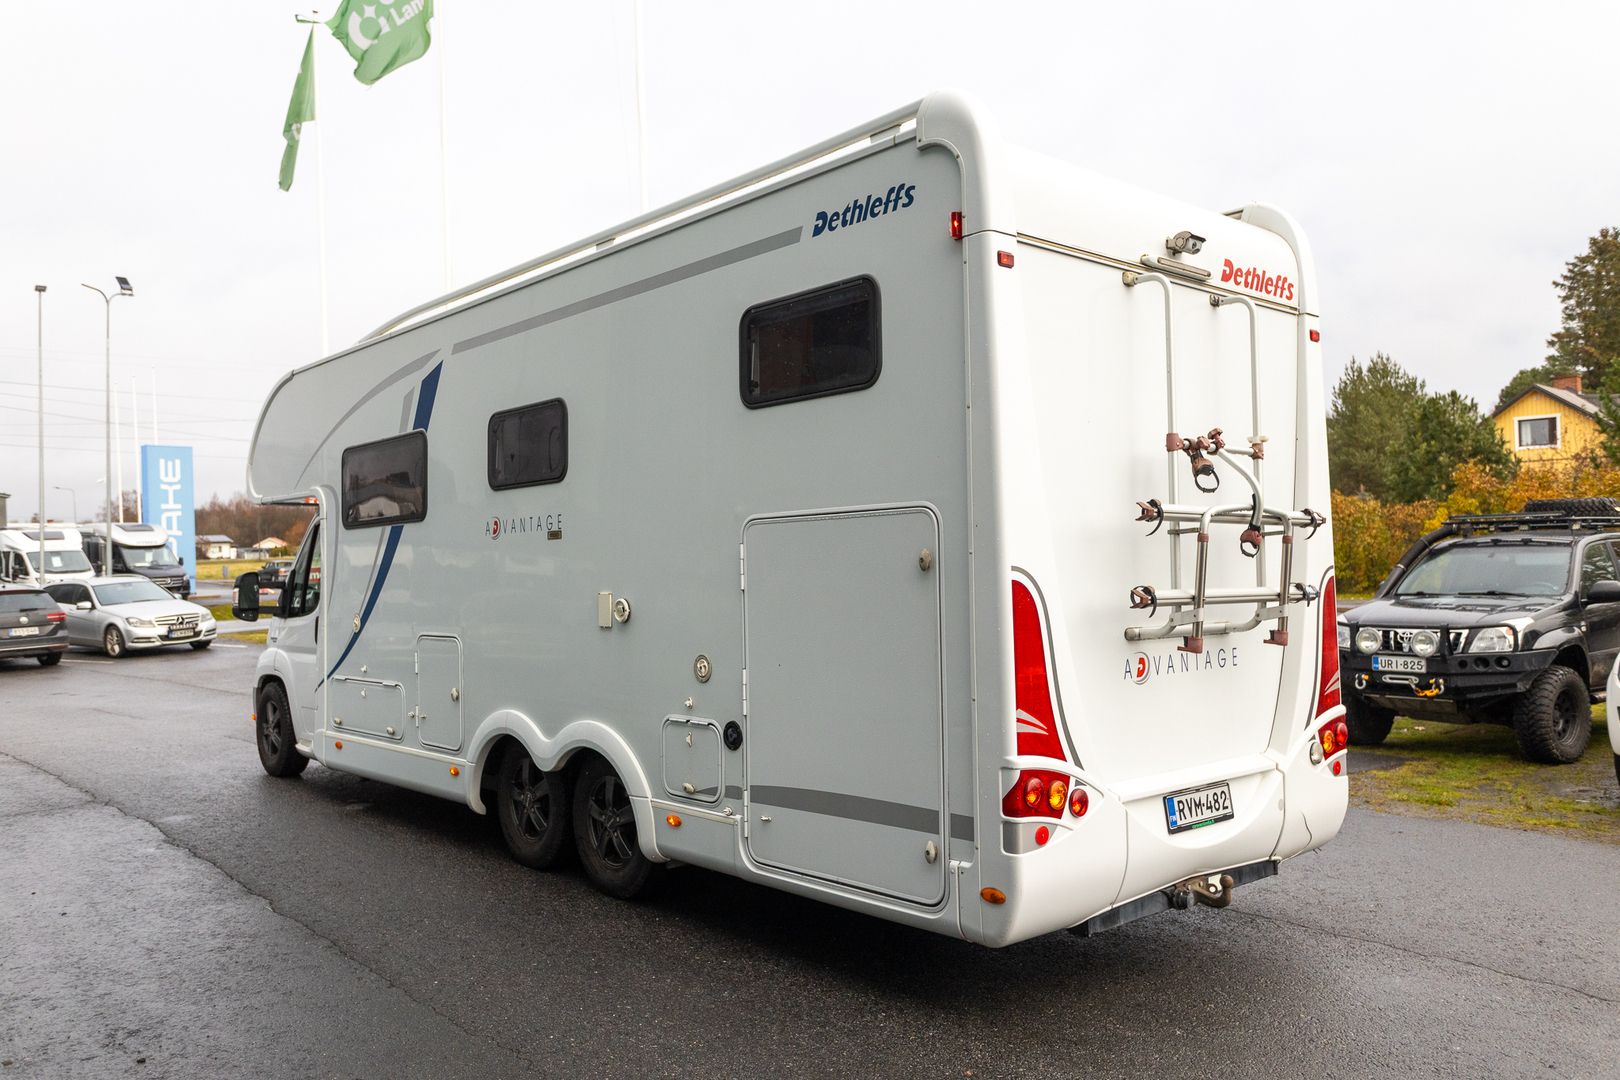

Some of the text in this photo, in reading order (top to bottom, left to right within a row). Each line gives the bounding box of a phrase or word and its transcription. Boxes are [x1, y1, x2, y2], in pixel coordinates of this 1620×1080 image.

[812, 183, 916, 238] Dethleffs
[1220, 258, 1294, 301] Dethleffs
[485, 513, 562, 539] ADVANTAGE
[1380, 659, 1423, 671] URI-825
[1177, 790, 1229, 821] RVM-482
